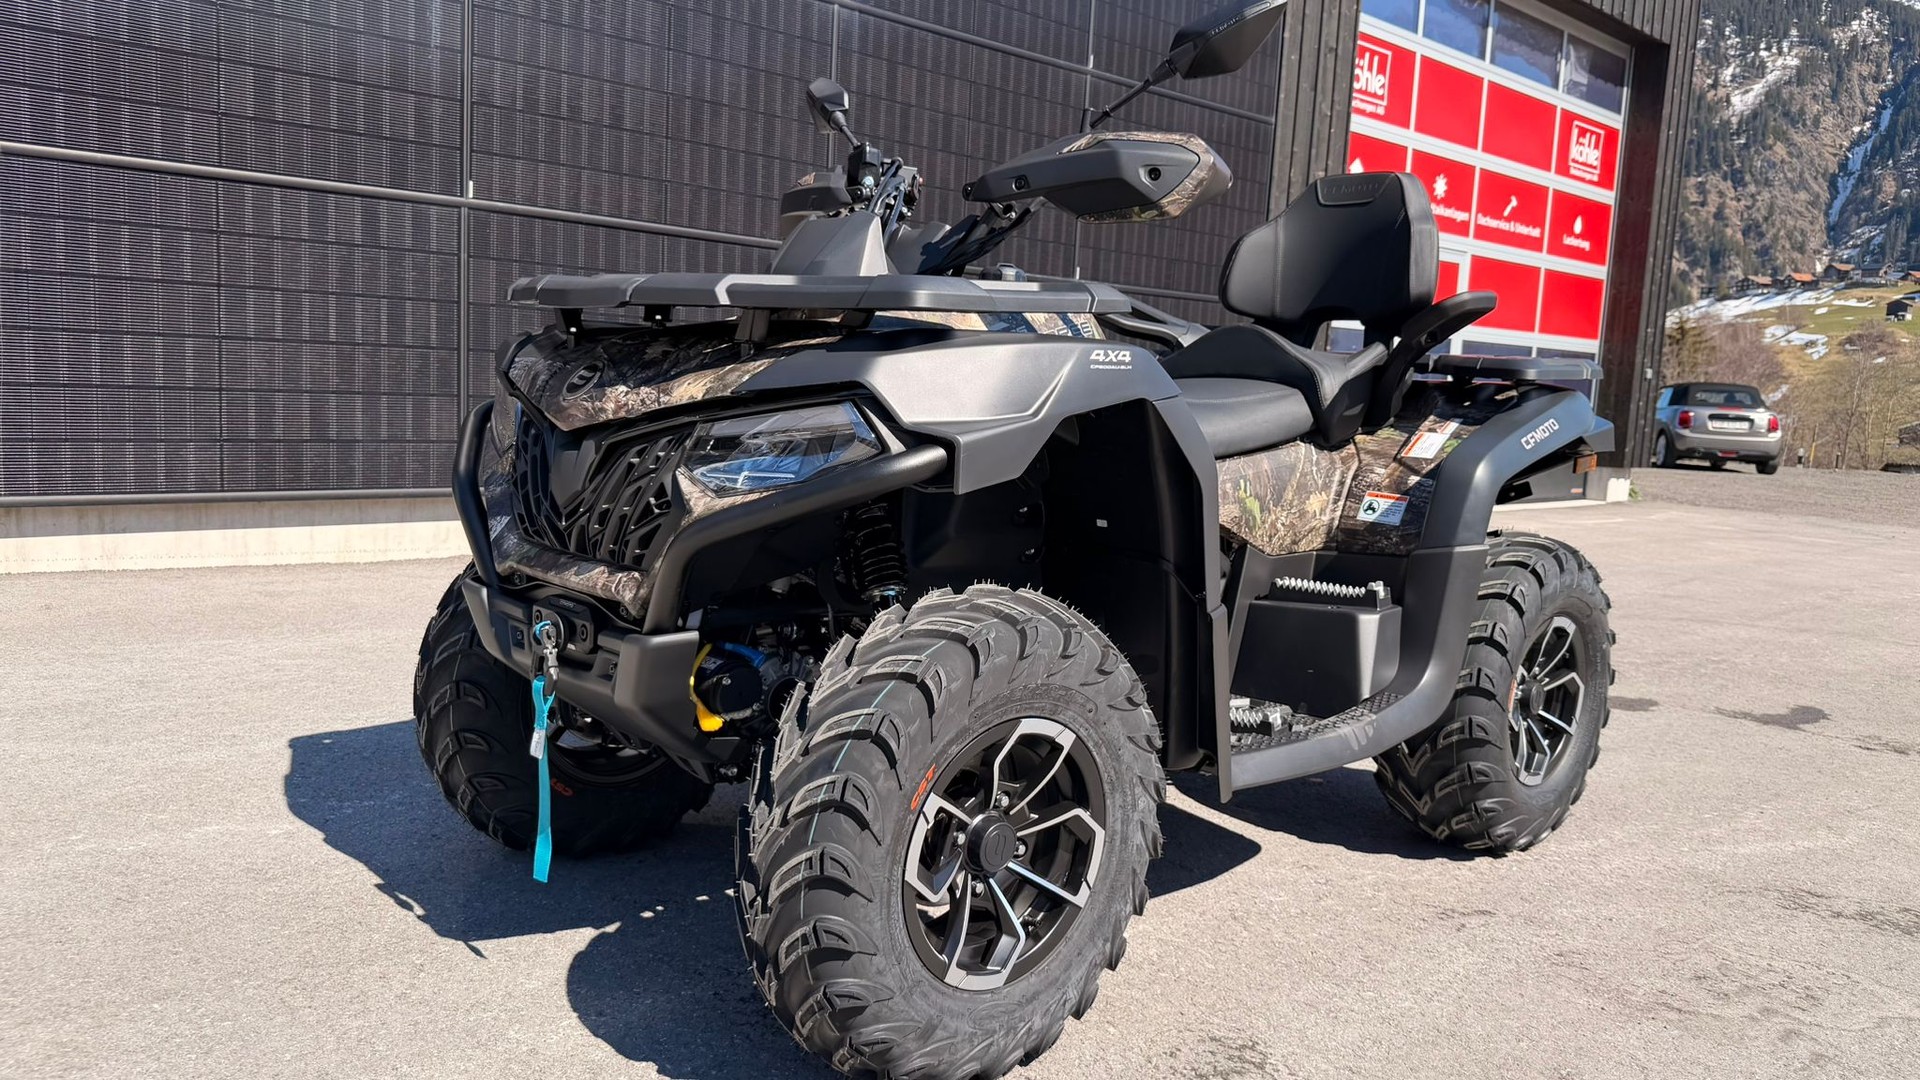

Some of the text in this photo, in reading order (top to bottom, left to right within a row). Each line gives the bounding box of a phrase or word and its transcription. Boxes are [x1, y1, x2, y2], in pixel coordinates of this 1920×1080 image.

[1353, 51, 1386, 96] öhle
[1569, 127, 1599, 166] köhle
[1090, 350, 1132, 362] 4X4
[1520, 418, 1560, 450] CFMOTO
